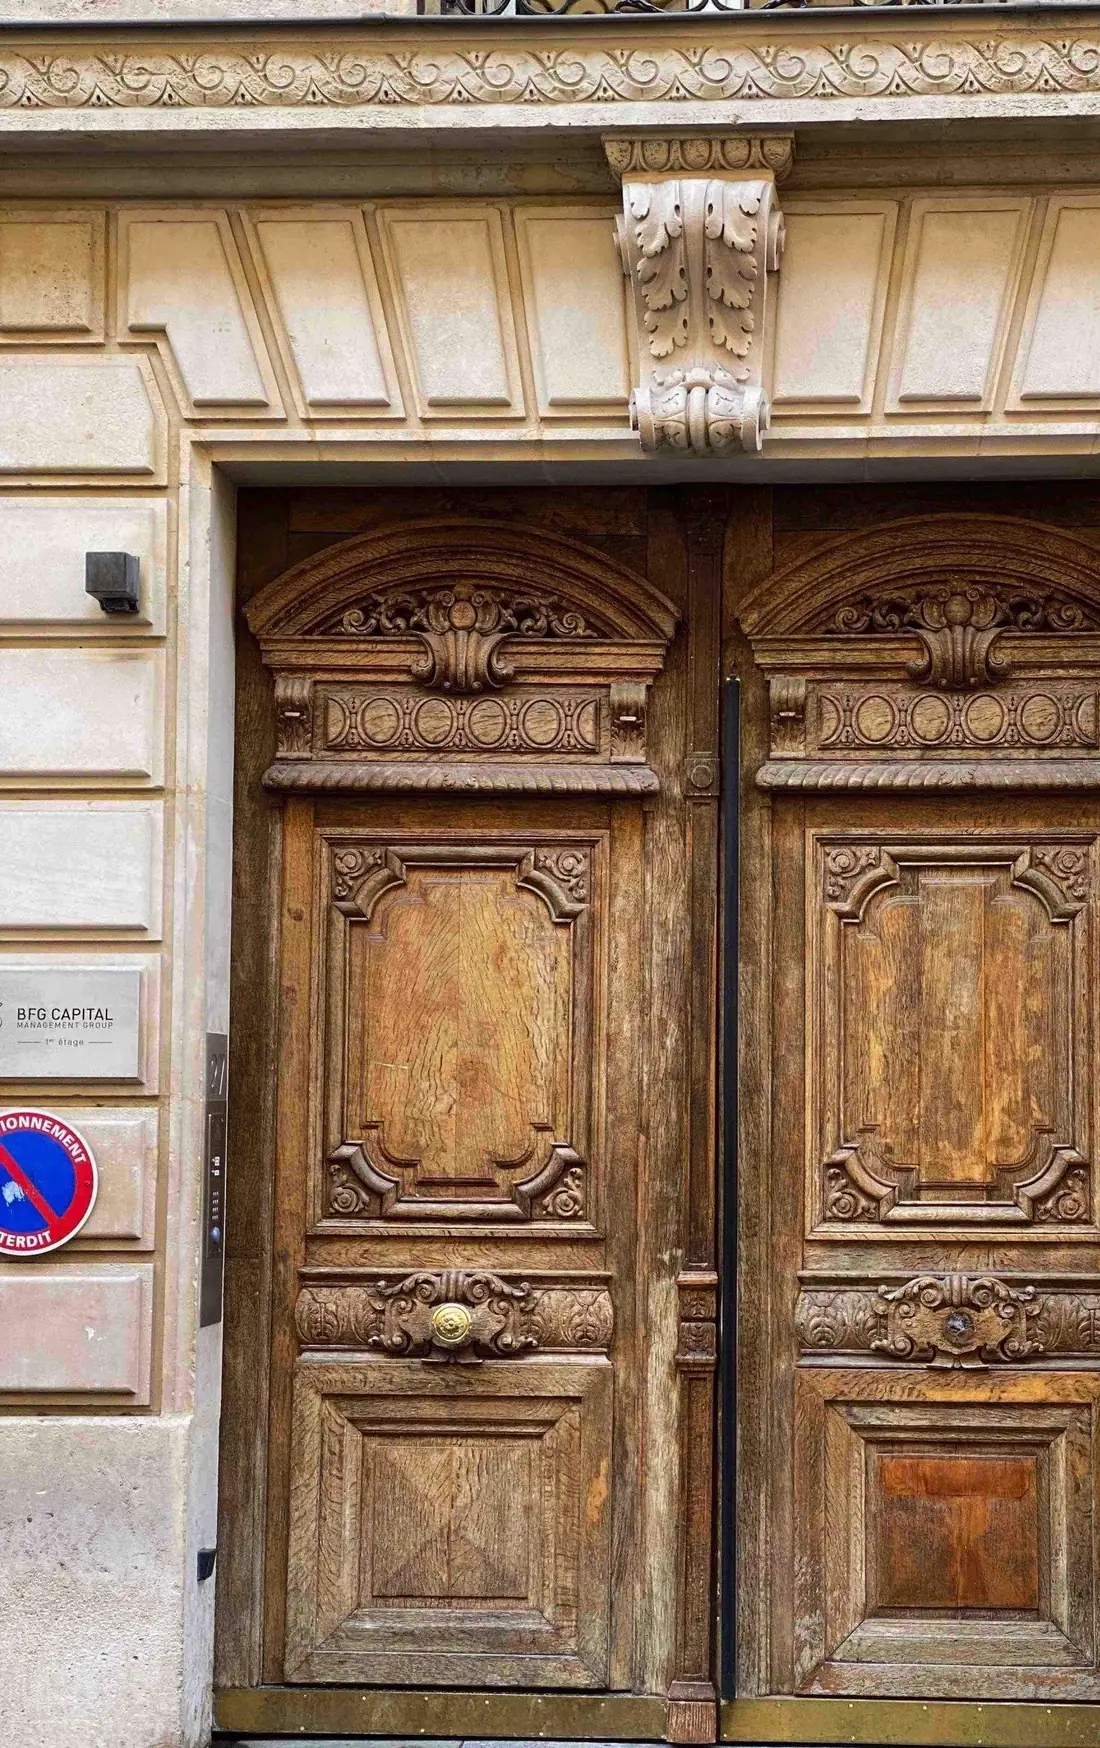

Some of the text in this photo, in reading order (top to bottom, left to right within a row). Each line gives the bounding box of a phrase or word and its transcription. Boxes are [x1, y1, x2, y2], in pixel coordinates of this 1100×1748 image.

[17, 1008, 113, 1020] BFG CAPITAL
[58, 1038, 84, 1047] étage
[0, 1115, 87, 1163] IONNEMENT
